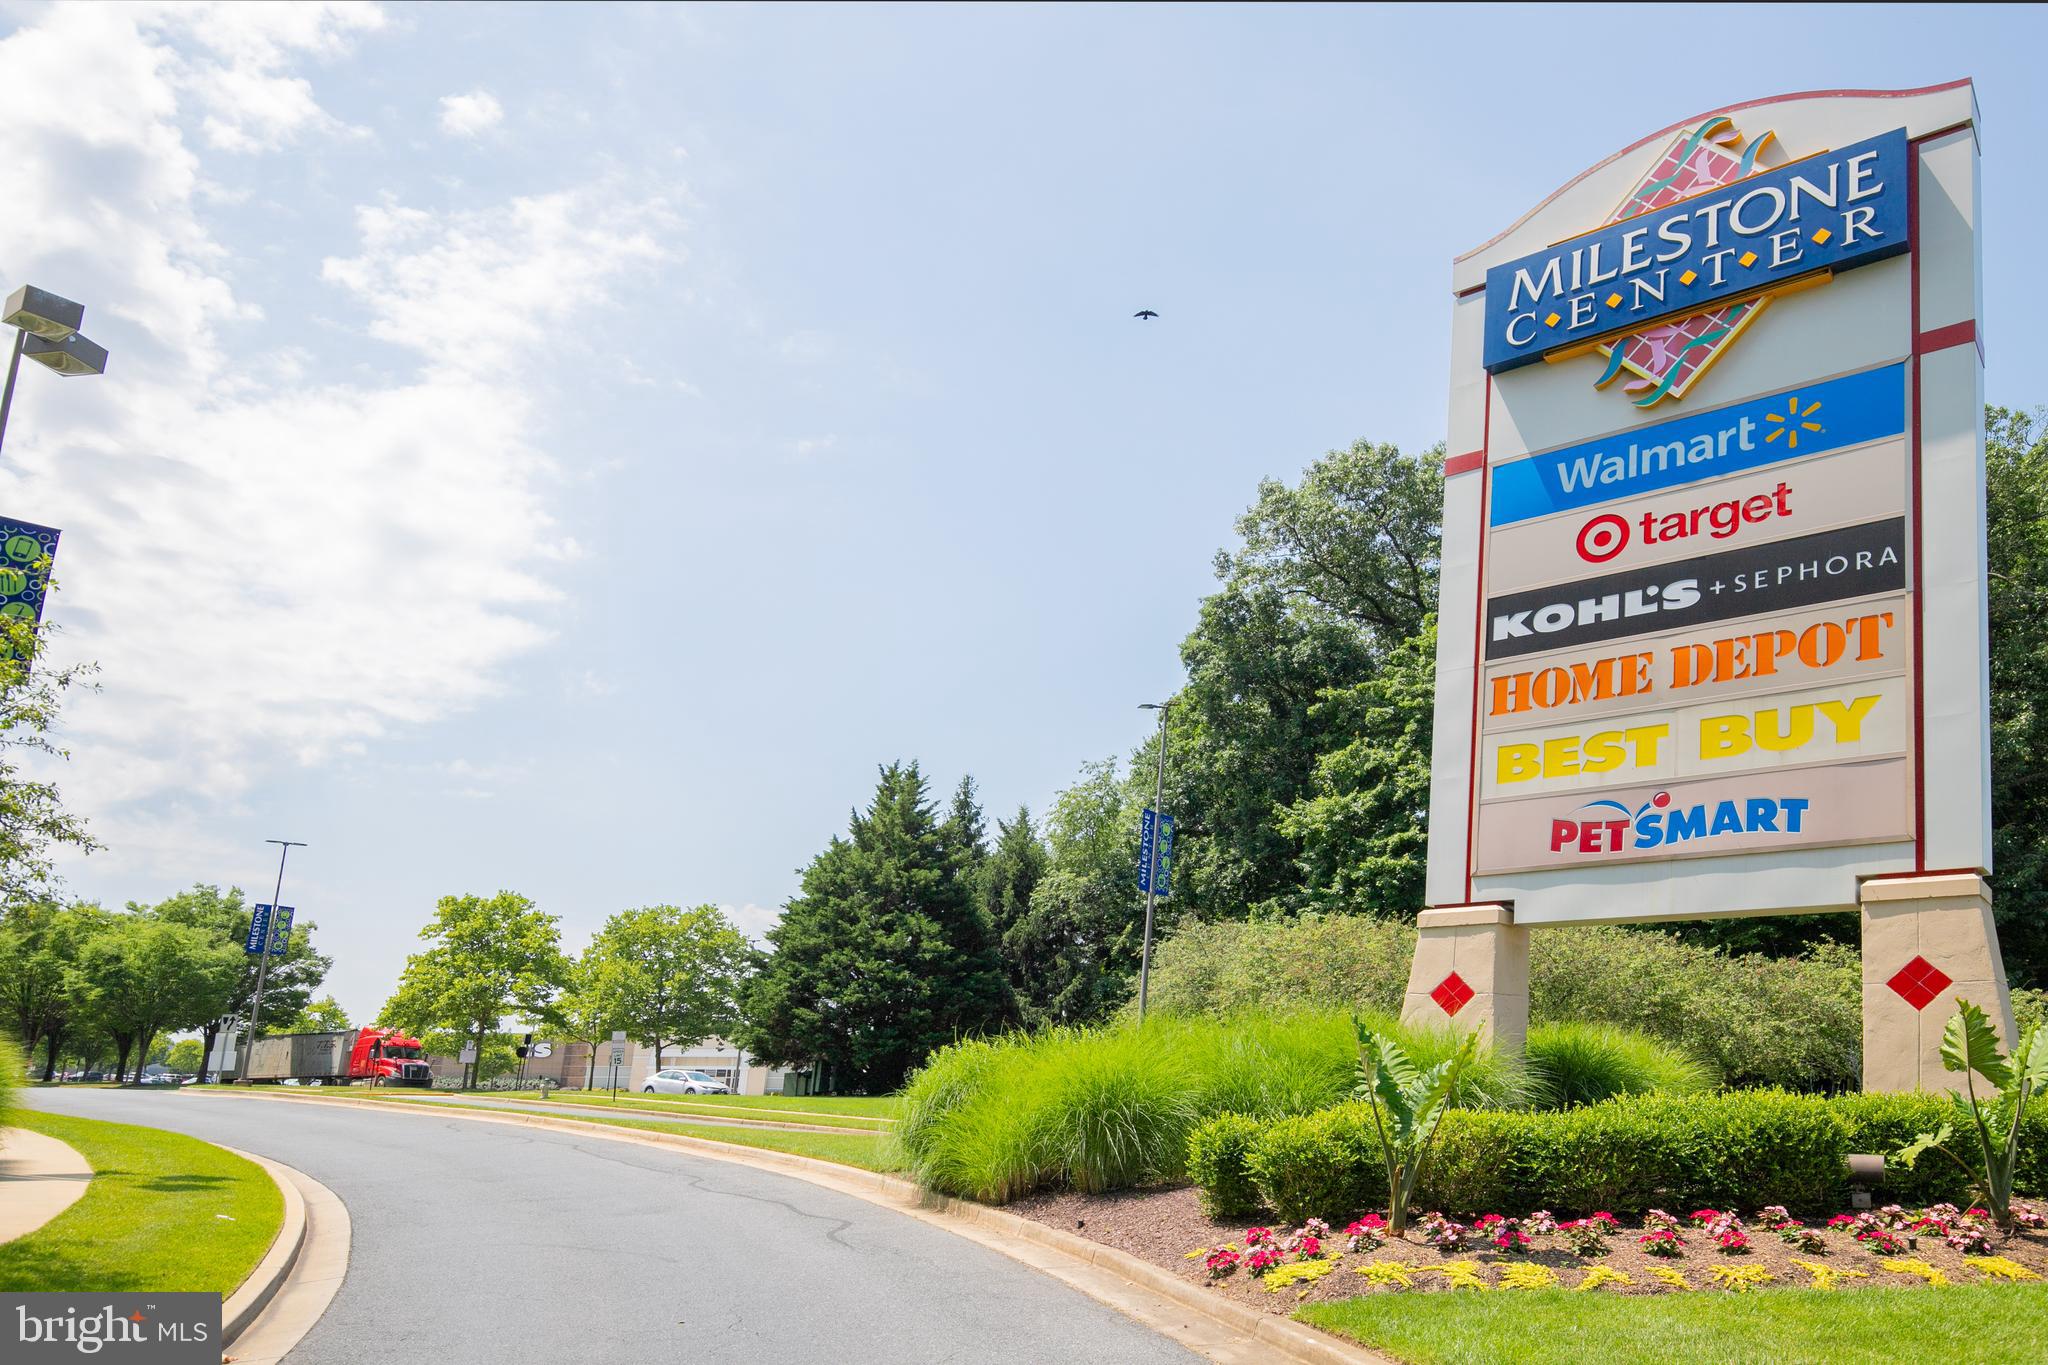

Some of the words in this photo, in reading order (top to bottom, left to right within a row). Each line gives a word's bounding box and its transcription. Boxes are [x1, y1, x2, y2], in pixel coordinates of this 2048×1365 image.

[1508, 149, 1885, 312] MILESTONE
[1557, 415, 1757, 493] Walmart
[1639, 482, 1793, 546] target
[1492, 578, 1702, 641] KOHL'S
[1734, 545, 1899, 593] SEPHORA
[1489, 651, 1654, 717] HOME
[1669, 612, 1894, 690] DEPOT
[1496, 723, 1669, 785] BEST
[1699, 695, 1883, 761] BUY
[1140, 812, 1151, 886] MILESTONE
[249, 905, 265, 950] MILESTONE
